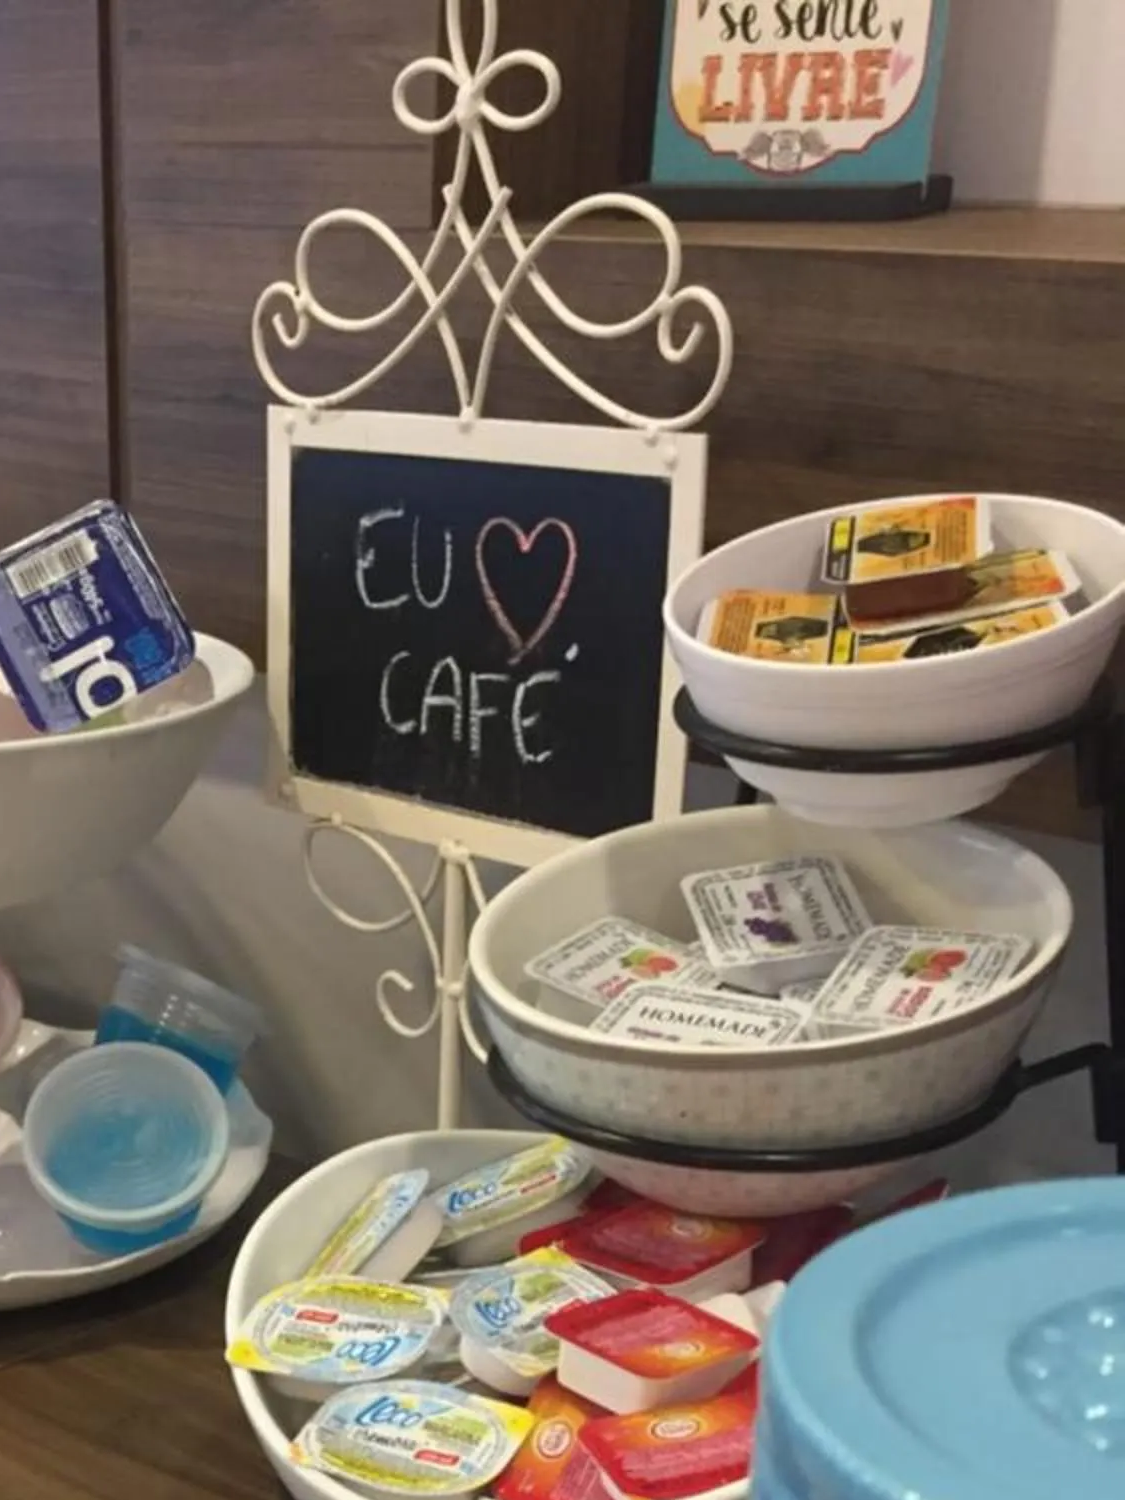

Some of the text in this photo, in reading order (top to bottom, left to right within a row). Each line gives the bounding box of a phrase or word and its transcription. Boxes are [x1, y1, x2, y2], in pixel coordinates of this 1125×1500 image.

[719, 2, 761, 43] se
[698, 48, 893, 123] LIVRE
[356, 508, 452, 609] EU
[379, 643, 579, 763] CAFÉ
[639, 1006, 767, 1038] HOMEMADE
